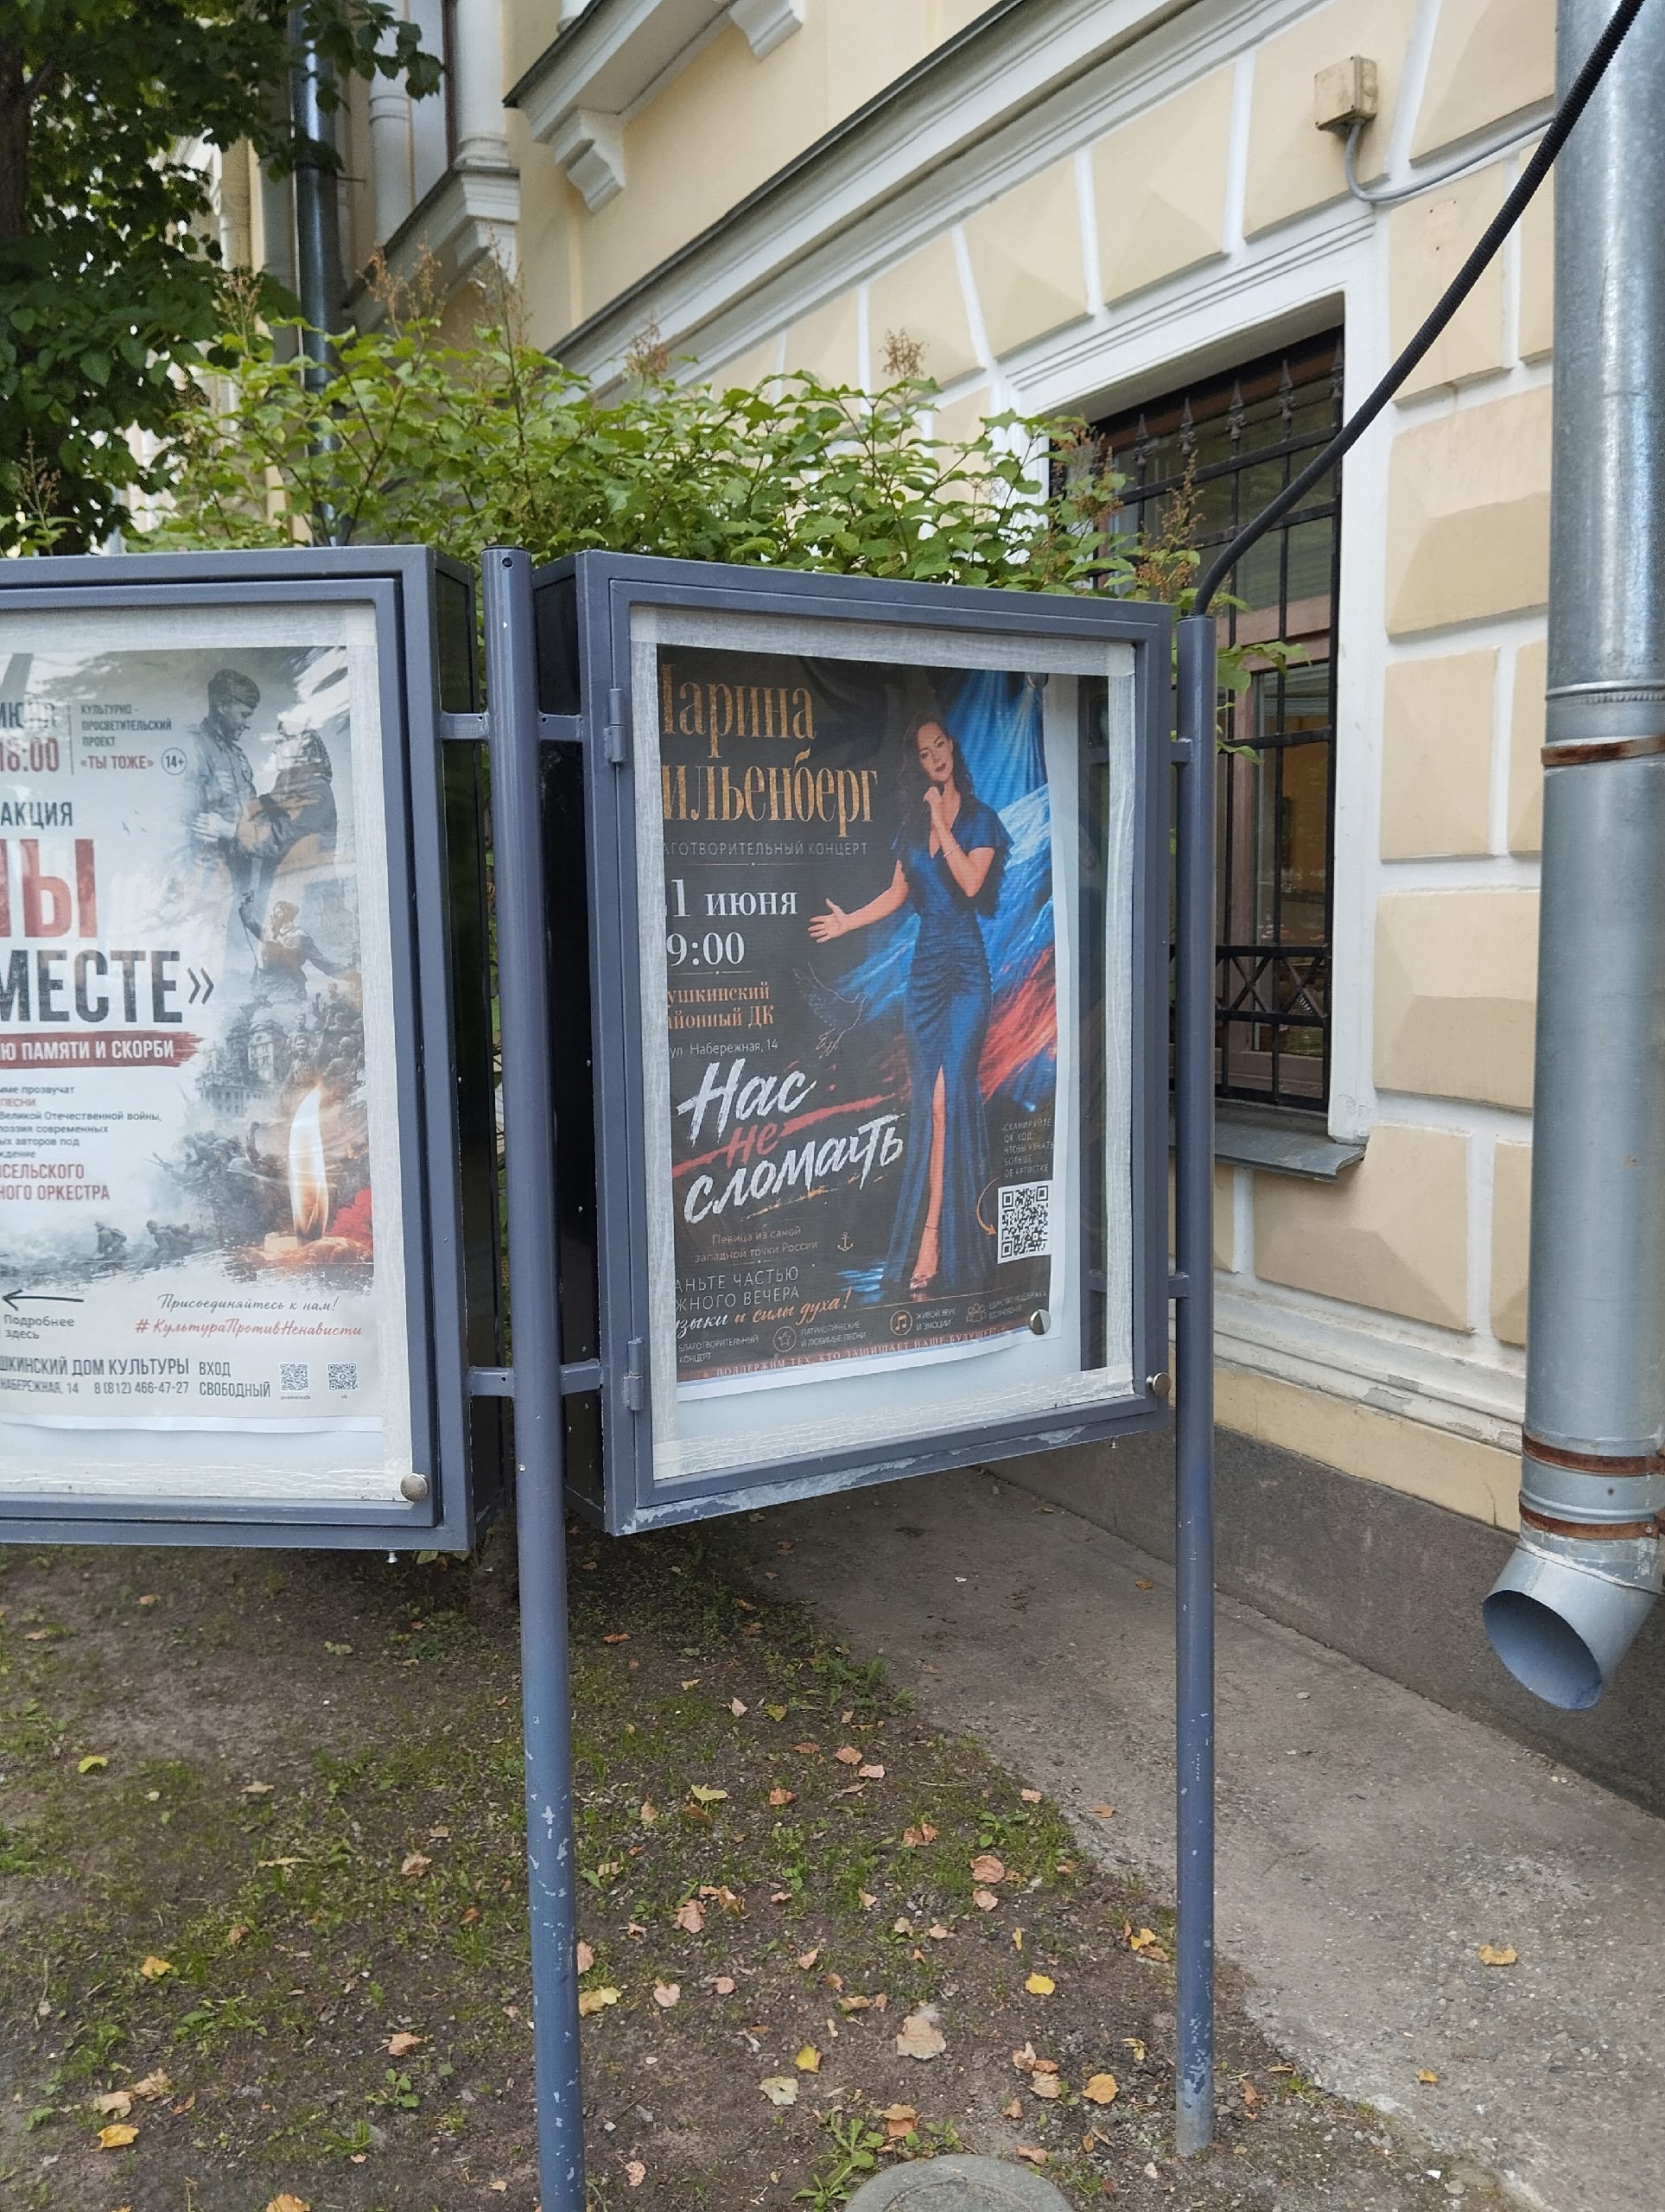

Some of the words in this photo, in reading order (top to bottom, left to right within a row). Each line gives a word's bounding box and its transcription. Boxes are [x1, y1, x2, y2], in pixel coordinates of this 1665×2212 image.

[81, 717, 172, 732] ПРОСВЕТИТЕЛЬСКИЙ
[82, 736, 117, 747] ПРОЕКТ
[80, 755, 107, 770] «ТЫ
[111, 755, 154, 770] ТОЖЕ»
[165, 755, 185, 768] 14+
[0, 802, 73, 830] АКЦИЯ
[809, 842, 868, 857] КОНЦЕРТ
[665, 879, 691, 917] 1
[704, 892, 798, 916] июня
[666, 931, 745, 967] 9:00
[667, 981, 769, 1007] ушкинский
[747, 1004, 774, 1029] ДК
[22, 1040, 91, 1061] ПАМЯТИ
[95, 1040, 106, 1059] И
[111, 1039, 175, 1059] СКОРБИ
[690, 1041, 764, 1057] Набережная,
[766, 1039, 778, 1050] 14
[22, 1087, 74, 1096] прозвучат
[676, 1058, 817, 1147] Нас
[44, 1111, 124, 1121] Отечественной
[127, 1111, 162, 1122] войны,
[36, 1126, 109, 1135] современных
[16, 1138, 56, 1147] авторов
[60, 1138, 80, 1147] под
[0, 1163, 85, 1179] СЕЛЬСКОГО
[683, 1113, 906, 1224] сломать
[37, 1185, 111, 1201] ОРКЕСТРА
[712, 1232, 753, 1245] Певица
[755, 1230, 767, 1240] из
[771, 1225, 802, 1238] самой
[695, 1249, 747, 1263] западной
[750, 1248, 779, 1257] точки
[782, 1241, 818, 1253] России
[734, 1266, 799, 1287] ЧАСТЬЮ
[157, 1293, 284, 1313] Присоединяйтесь
[289, 1302, 298, 1311] к
[302, 1296, 340, 1312] нам!
[744, 1286, 799, 1306] ВЕЧЕРА
[734, 1313, 746, 1324] и
[753, 1306, 795, 1323] силы
[796, 1285, 852, 1325] духа!
[3, 1314, 75, 1328] Подробнее
[801, 1320, 861, 1336] ПАТРИОТИЧЕСКИЕ
[5, 1329, 40, 1339] здесь
[843, 1331, 866, 1341] ПЕСНИ
[679, 1335, 759, 1352] БЛАГОТВОРИТЕЛЬНЫЙ
[679, 1352, 711, 1363] КОНЦЕРТ
[72, 1358, 105, 1376] ДОМ
[108, 1357, 189, 1376] КУЛЬТУРЫ
[199, 1361, 232, 1378] ВХОД
[716, 1359, 785, 1376] ПОДДЕРЖИМ
[67, 1382, 79, 1394] 14
[94, 1382, 101, 1395] 8
[104, 1382, 130, 1395] (812)
[135, 1382, 189, 1395] 466-47-27
[199, 1381, 271, 1399] СВОБОДНЫЙ
